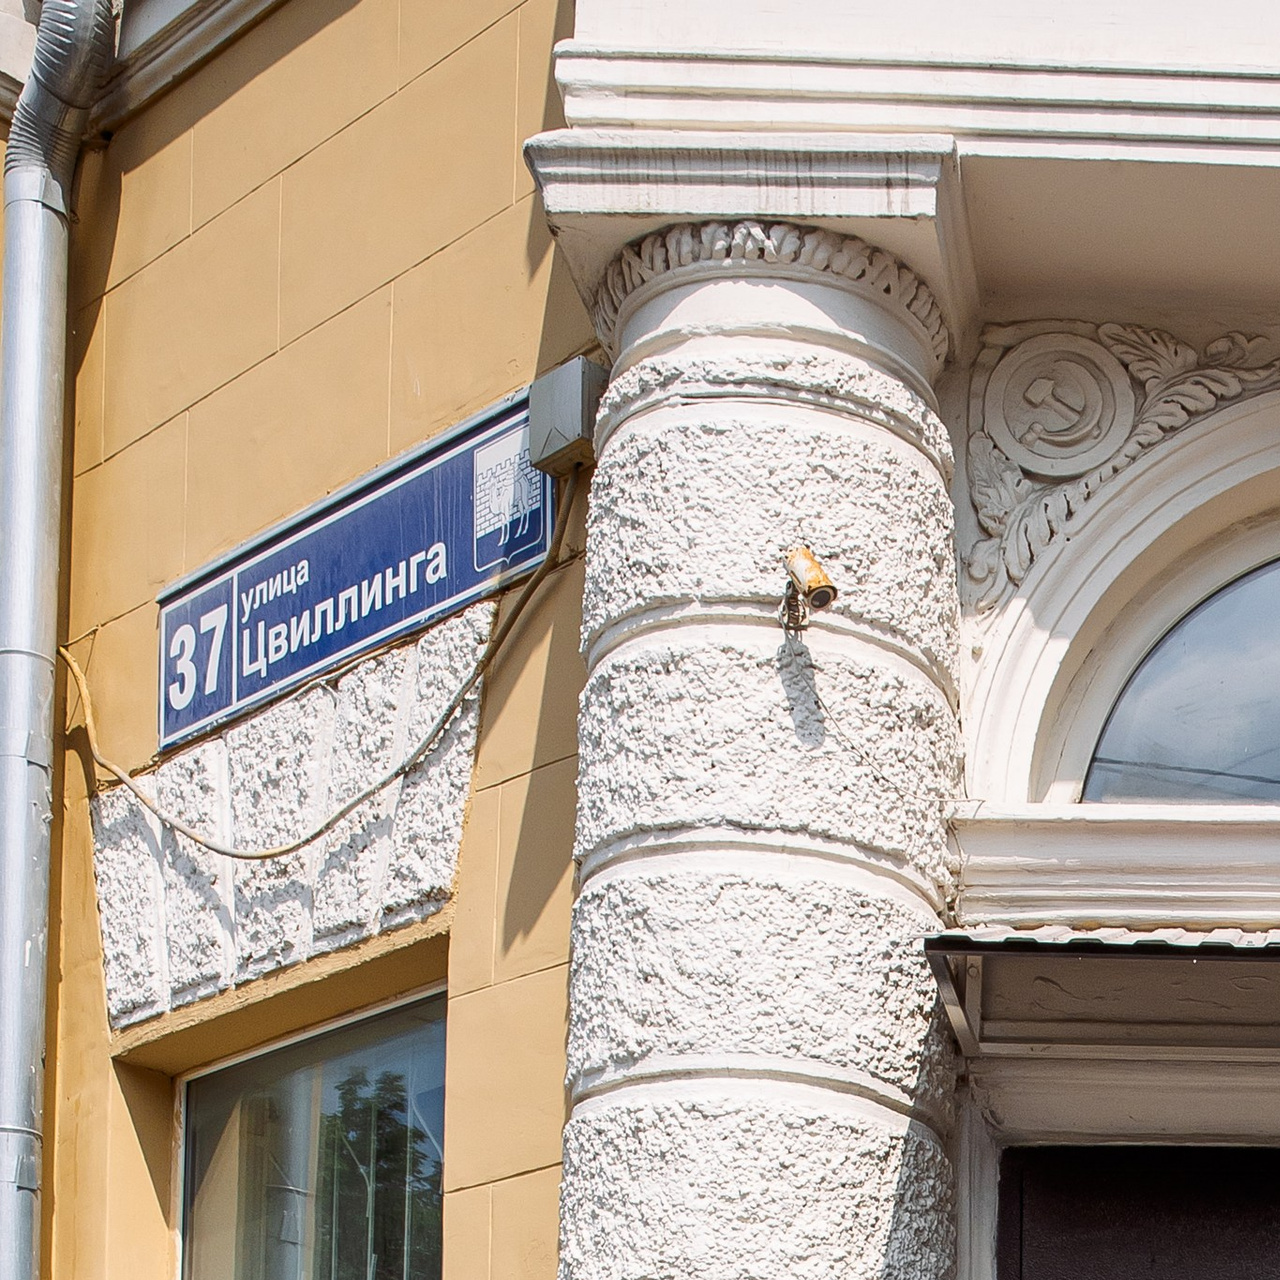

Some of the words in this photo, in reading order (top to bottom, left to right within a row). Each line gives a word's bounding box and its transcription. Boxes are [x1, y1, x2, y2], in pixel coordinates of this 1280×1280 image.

[241, 558, 310, 625] улица
[242, 541, 448, 679] Цвиллинга
[168, 604, 228, 712] 37
